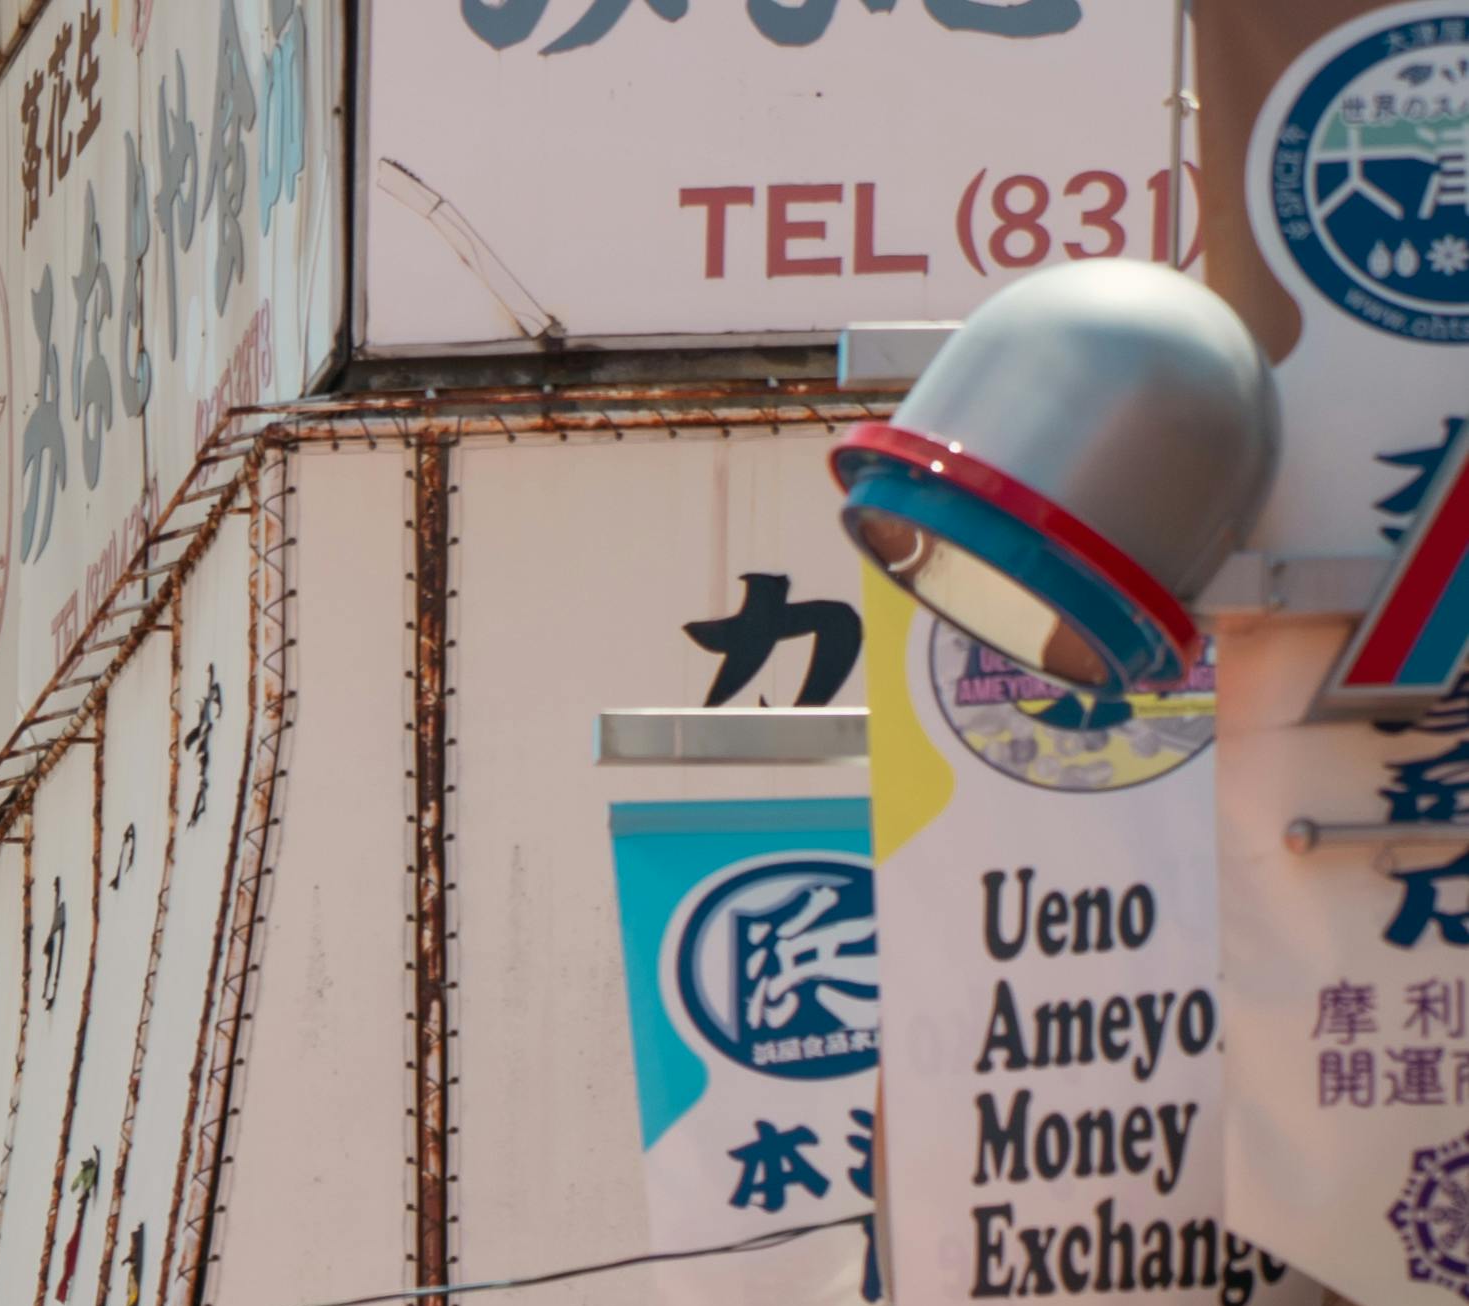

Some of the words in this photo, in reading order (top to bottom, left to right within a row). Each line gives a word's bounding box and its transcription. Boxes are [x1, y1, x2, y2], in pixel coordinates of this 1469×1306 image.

[679, 181, 929, 280] TEL
[981, 867, 1157, 962] Ueno
[974, 975, 1225, 1082] Ameyo
[970, 1082, 1198, 1194] Money
